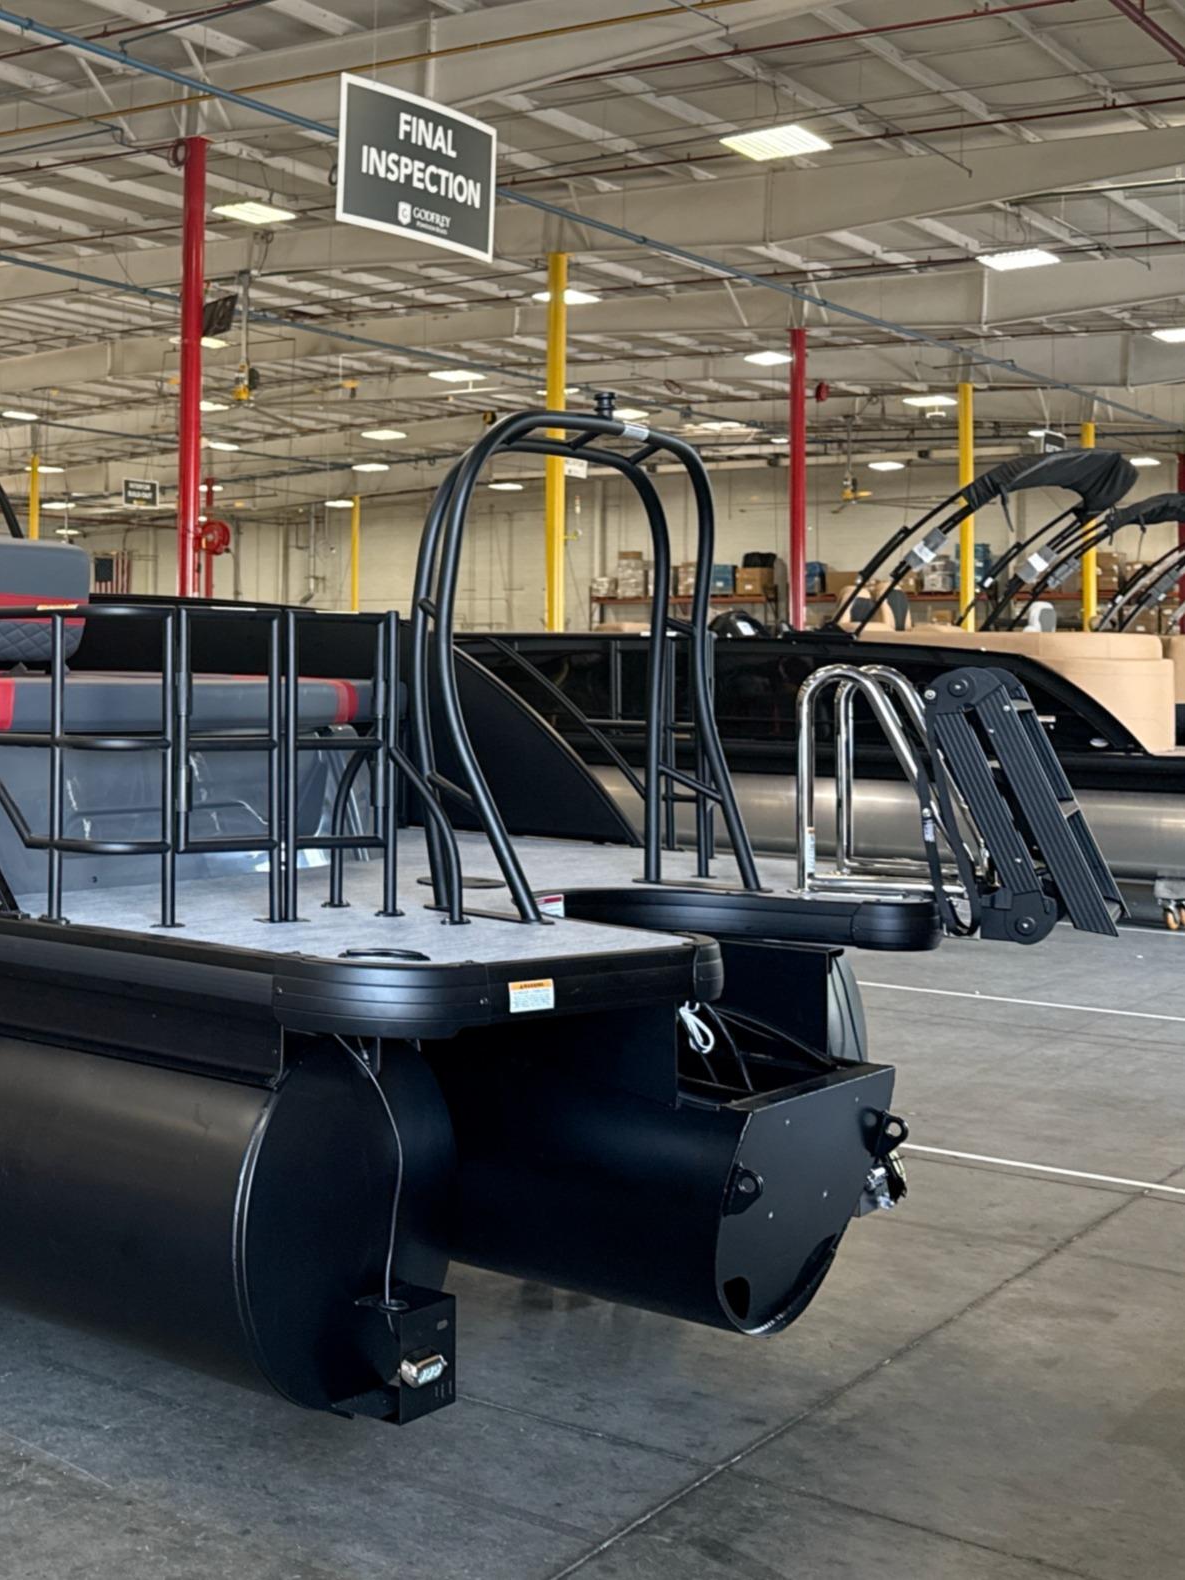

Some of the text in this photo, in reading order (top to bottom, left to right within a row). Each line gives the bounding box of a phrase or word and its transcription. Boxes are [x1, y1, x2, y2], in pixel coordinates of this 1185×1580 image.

[398, 112, 457, 158] FINAL
[361, 145, 481, 209] INSPECTION
[412, 206, 452, 228] GODFREY
